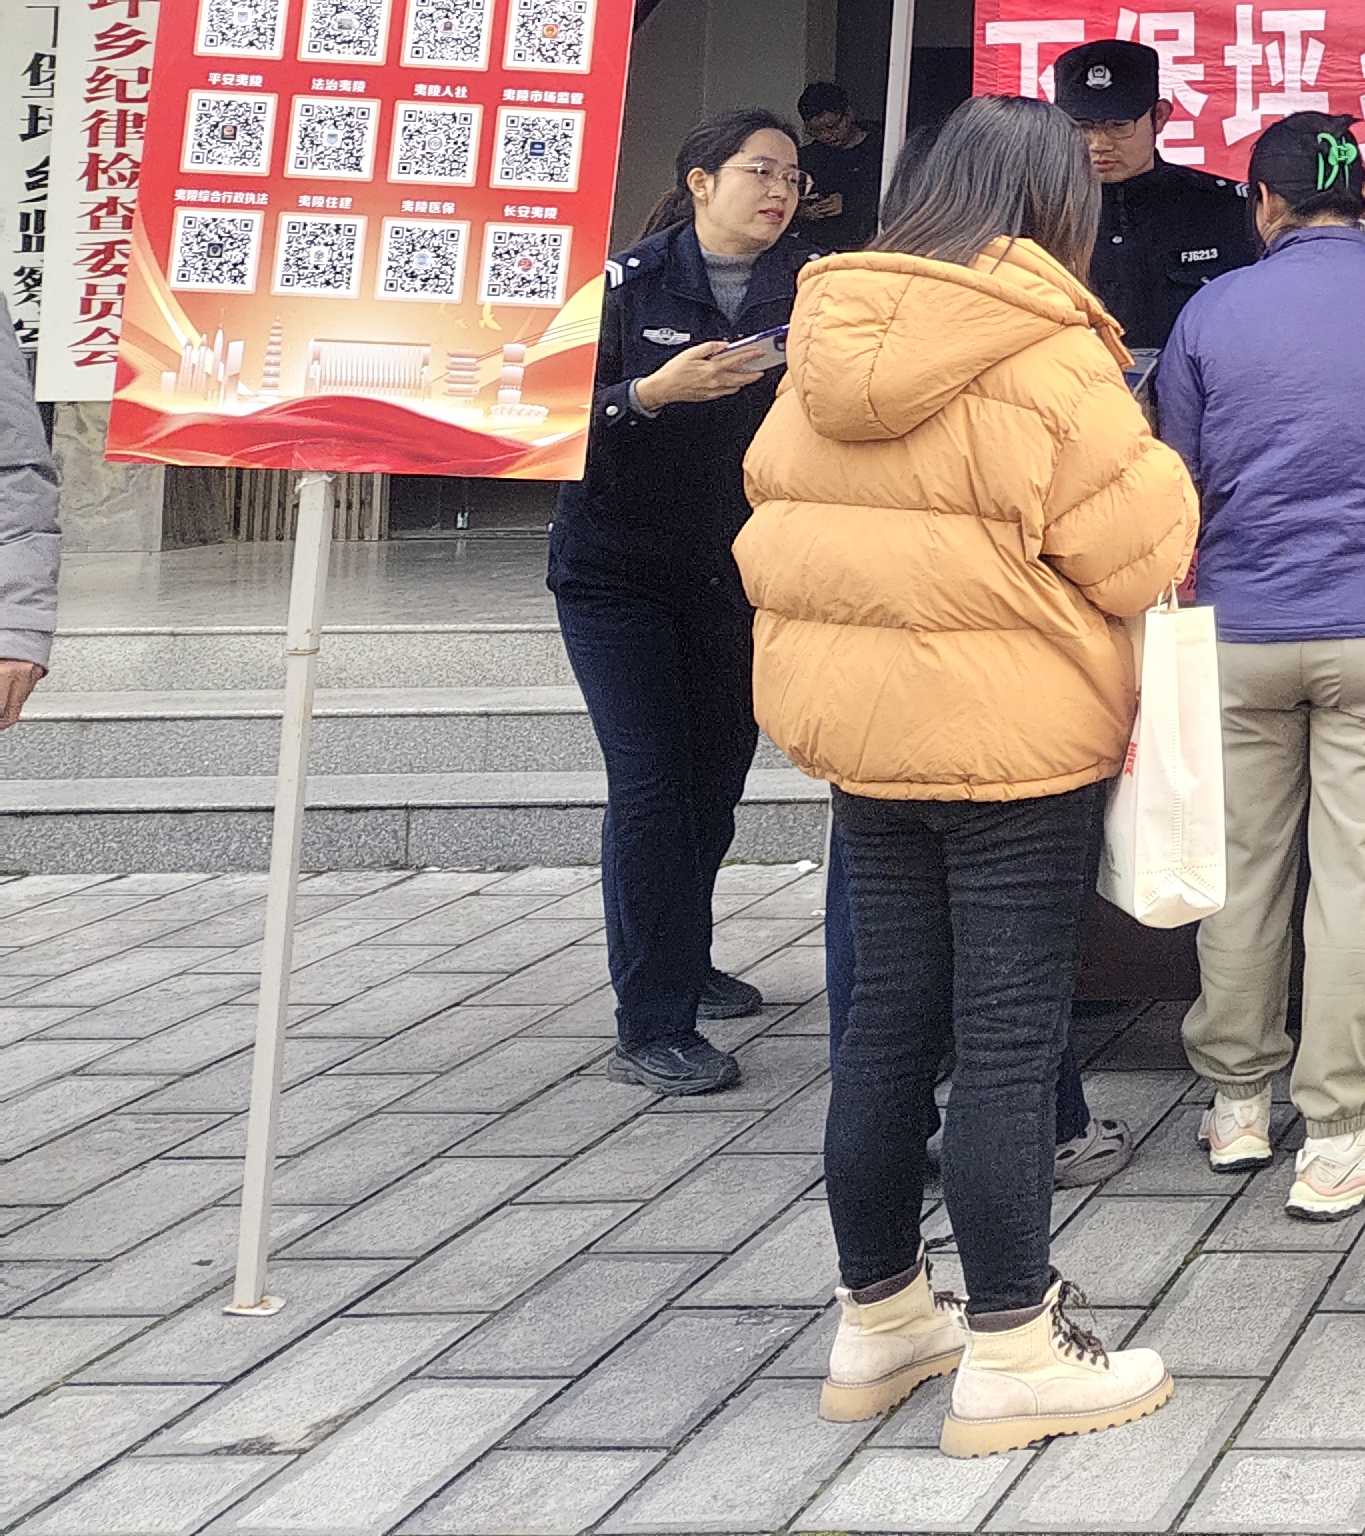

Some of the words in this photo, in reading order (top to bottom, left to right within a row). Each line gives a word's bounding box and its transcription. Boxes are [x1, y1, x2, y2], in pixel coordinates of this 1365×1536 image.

[208, 72, 263, 88] 平安夷陵
[311, 78, 366, 94] 法治夷陵
[413, 83, 468, 99] 夷陵人社
[502, 88, 584, 105] 夷陵市场监管
[174, 188, 269, 206] 夷陵综合行政执法
[298, 195, 353, 210] 夷陵住建
[401, 199, 456, 215] 夷陵医保
[503, 205, 558, 221] 长安夷陵
